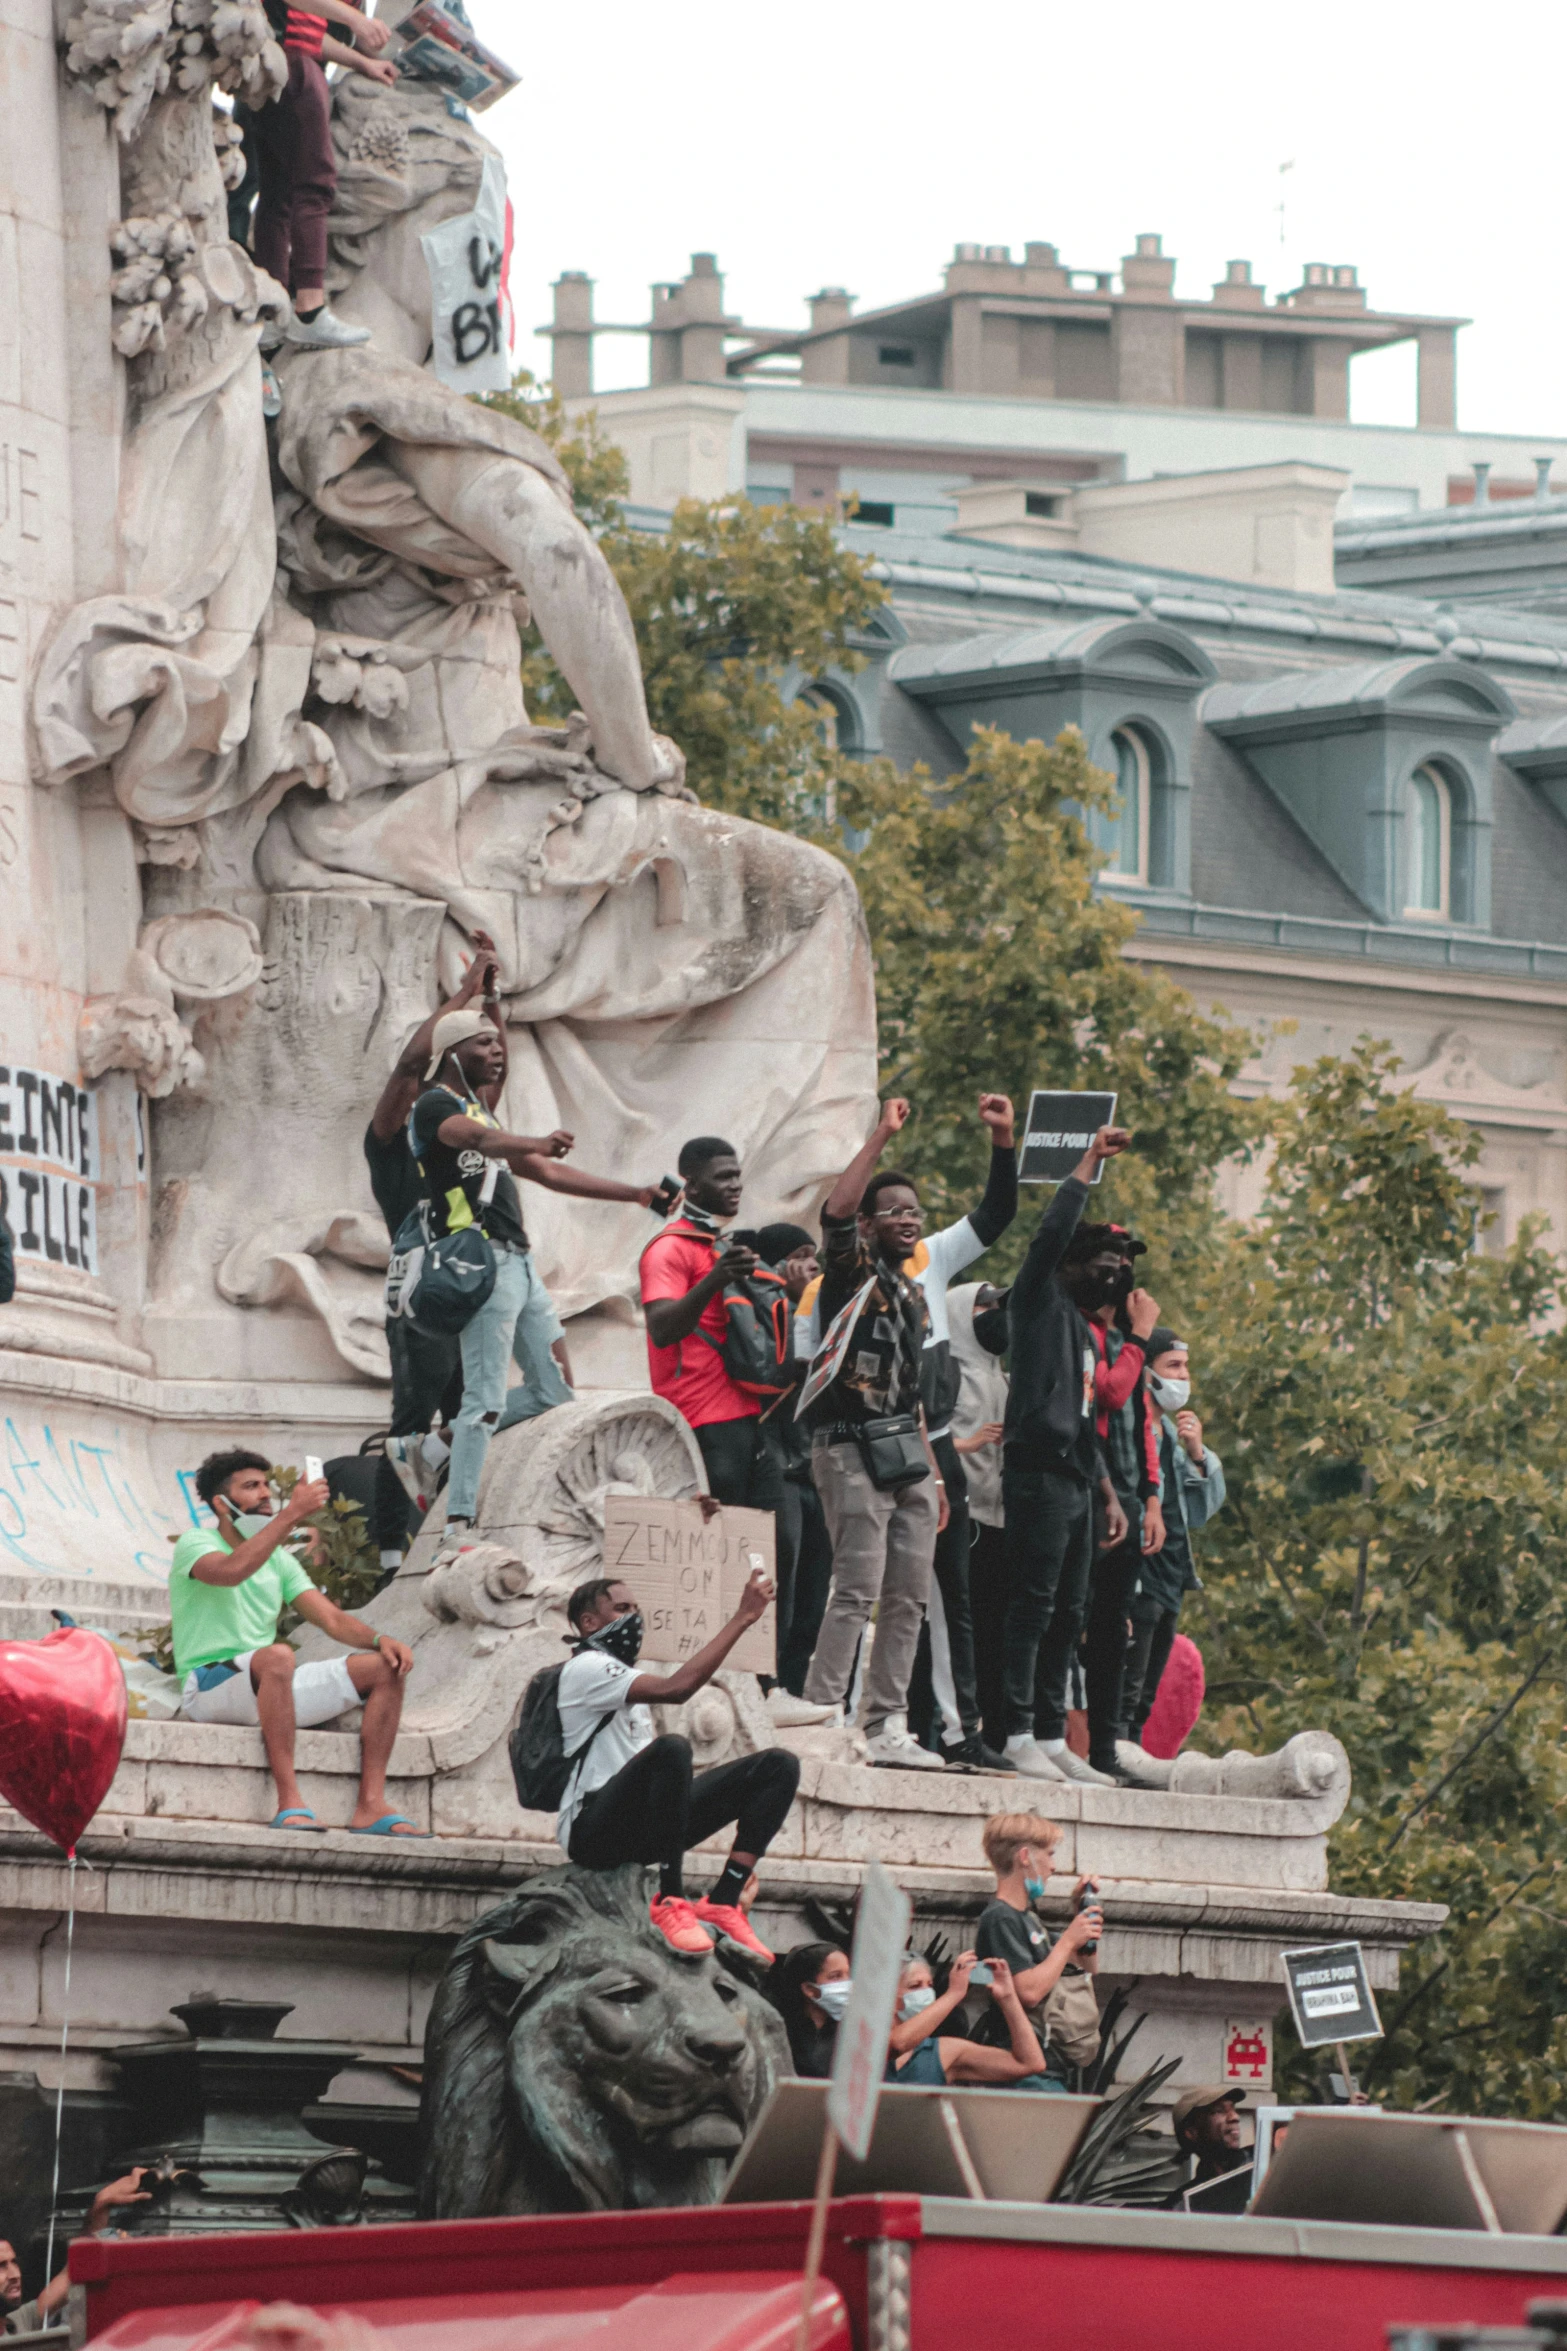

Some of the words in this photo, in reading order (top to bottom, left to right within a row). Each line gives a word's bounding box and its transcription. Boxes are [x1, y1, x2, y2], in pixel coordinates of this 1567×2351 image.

[1025, 1132, 1062, 1148] JUSTICE
[1061, 1132, 1089, 1148] POUR
[614, 1521, 750, 1568] ZEMMOUR
[680, 1566, 713, 1598] ON
[683, 1609, 708, 1632] TA
[1295, 1969, 1331, 1987] JUSTICE
[1330, 1965, 1358, 1981] POUR
